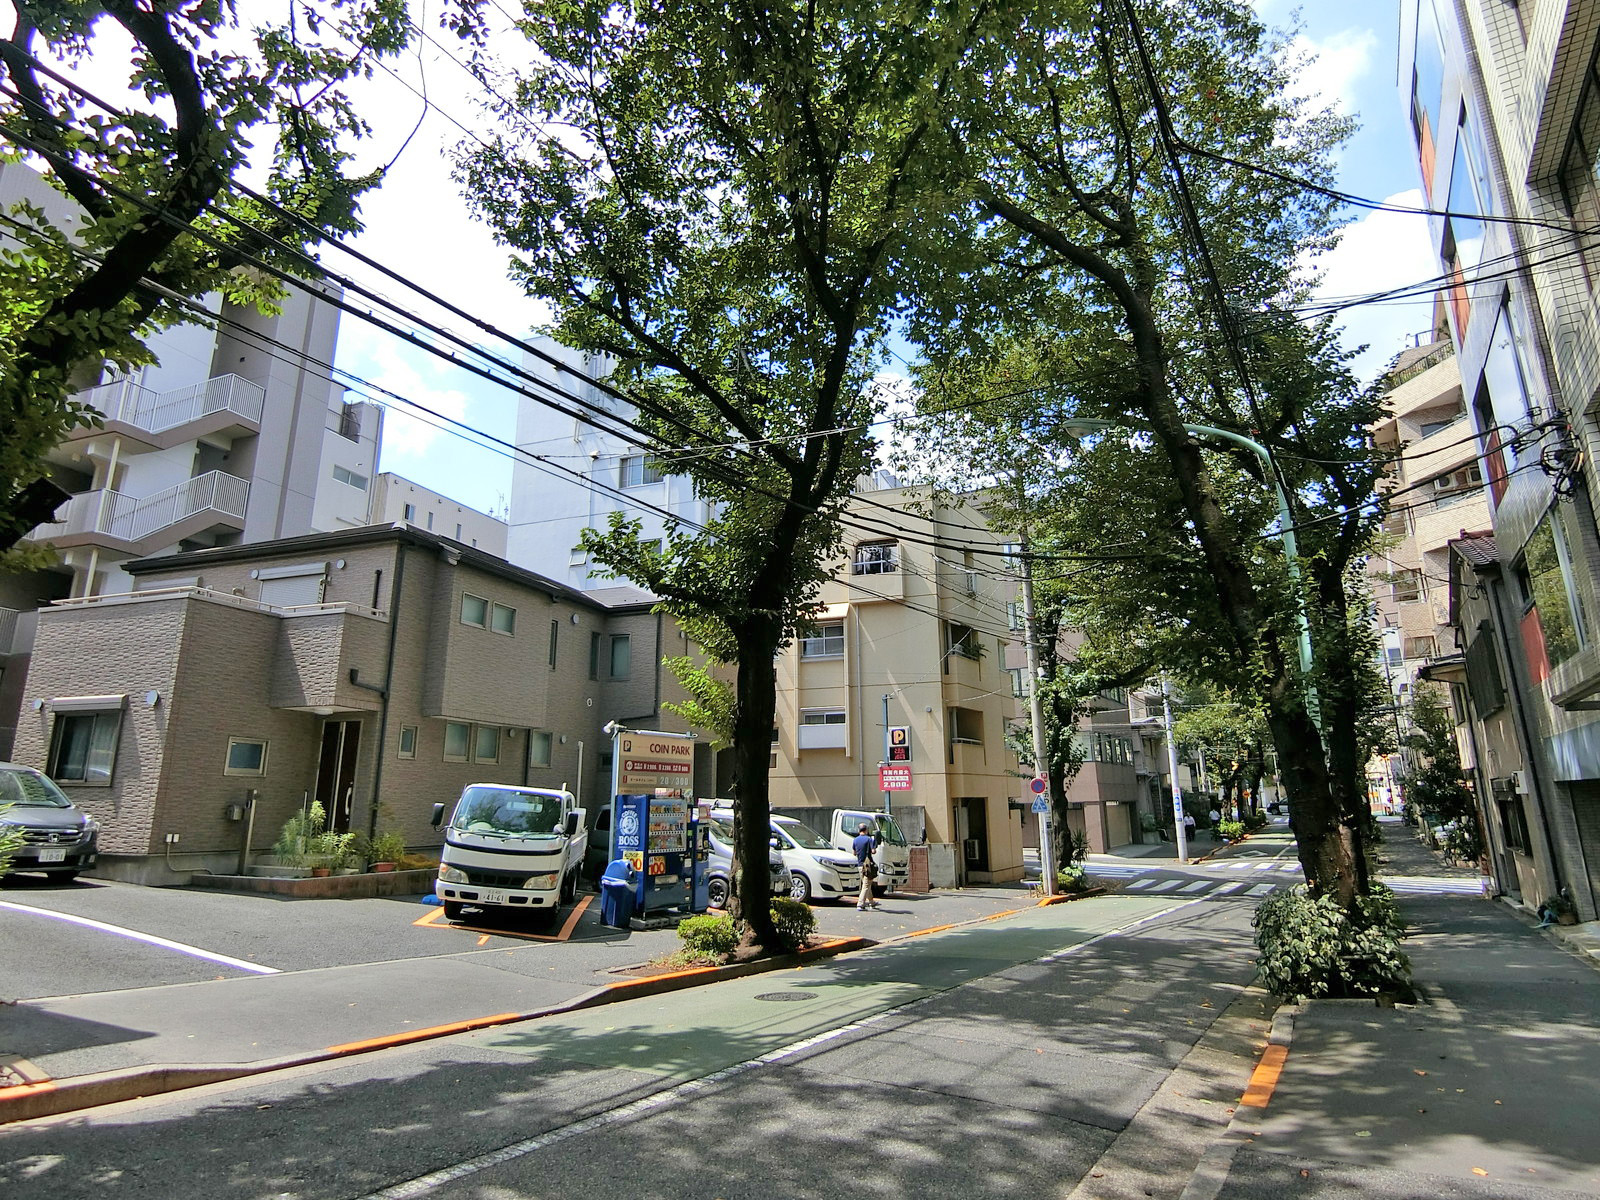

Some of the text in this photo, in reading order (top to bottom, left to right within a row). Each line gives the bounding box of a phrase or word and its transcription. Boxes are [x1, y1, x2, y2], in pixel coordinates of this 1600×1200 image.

[893, 730, 904, 744] P
[650, 743, 690, 755] COIN PARK
[621, 810, 638, 818] COFFEE
[618, 835, 639, 846] BOSS
[649, 862, 665, 875] 100
